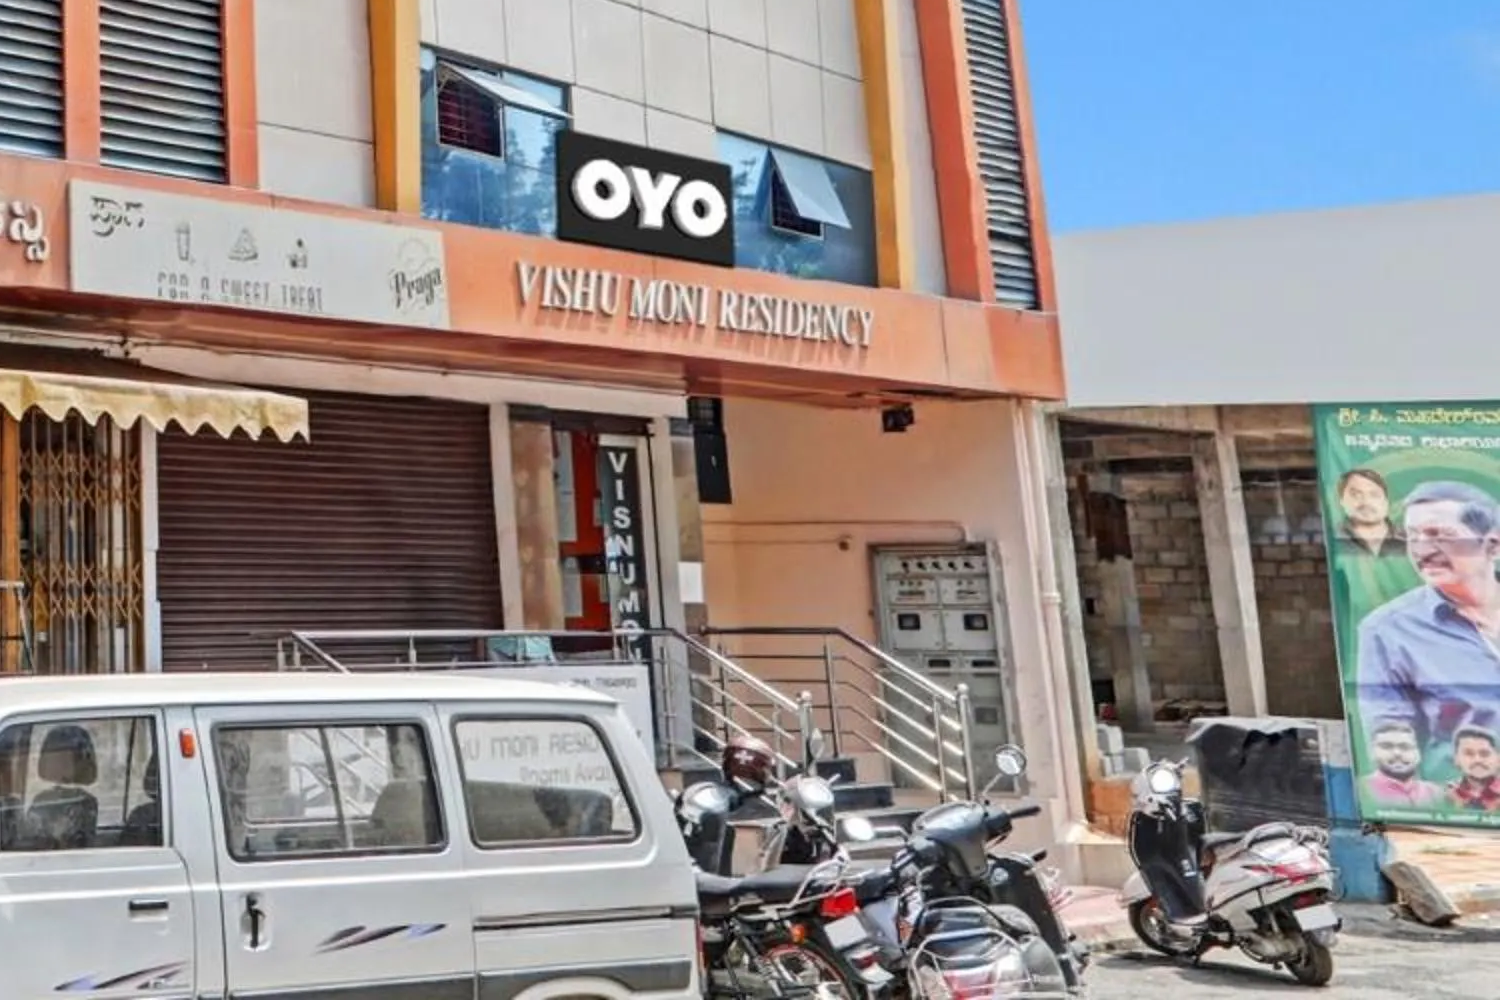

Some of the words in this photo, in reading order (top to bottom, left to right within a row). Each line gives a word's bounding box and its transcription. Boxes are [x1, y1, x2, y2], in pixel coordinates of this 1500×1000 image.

[572, 158, 728, 239] OYO
[390, 267, 443, 309] Praga
[516, 260, 623, 318] VISHU
[629, 277, 712, 327] MONI
[717, 288, 875, 349] RESIDENCY
